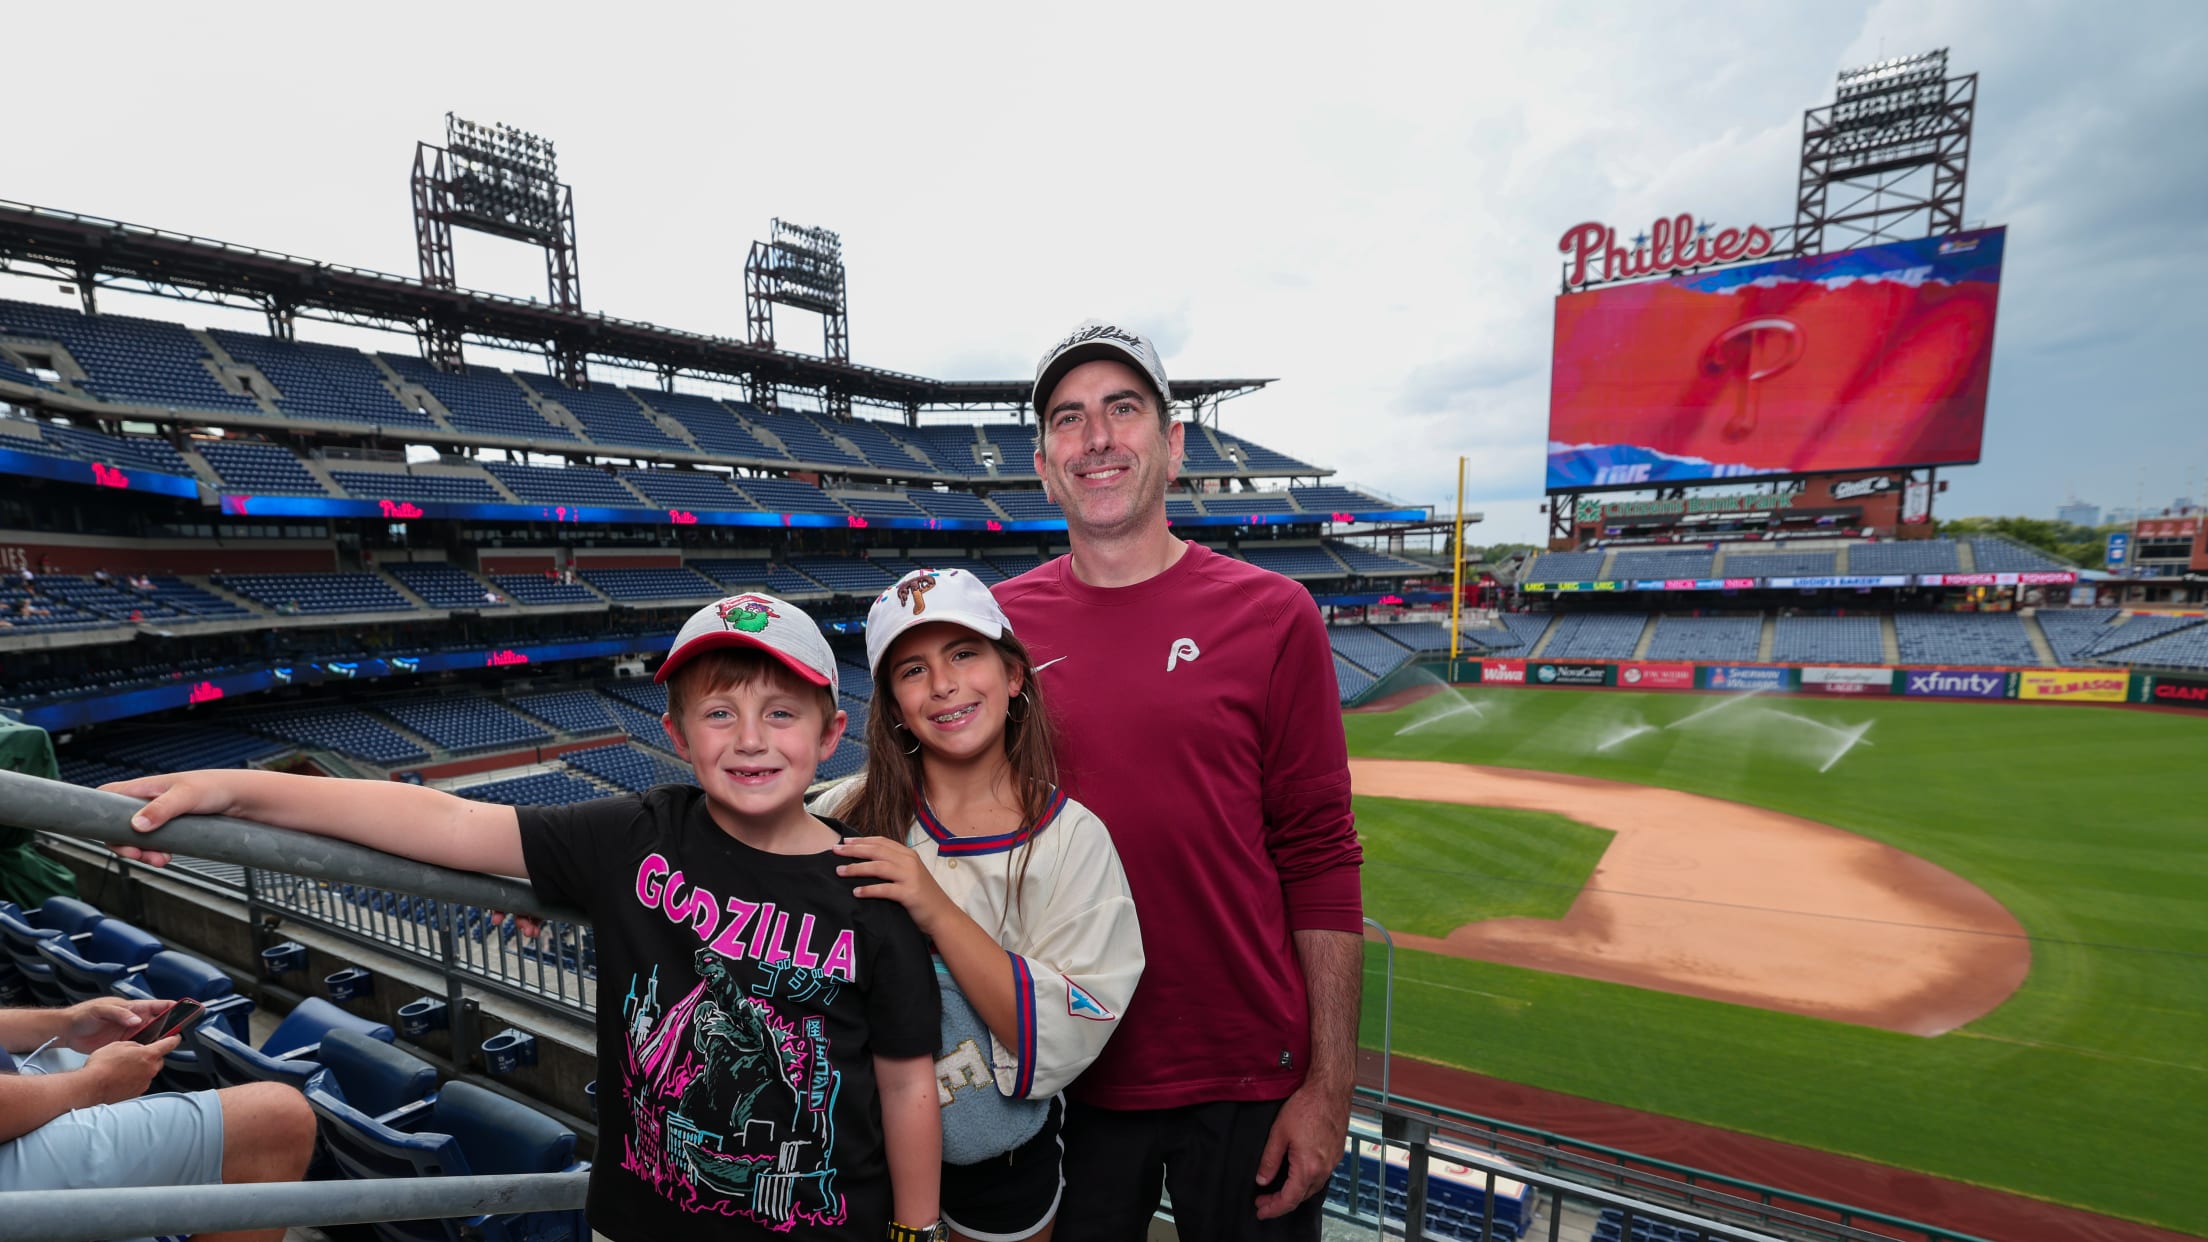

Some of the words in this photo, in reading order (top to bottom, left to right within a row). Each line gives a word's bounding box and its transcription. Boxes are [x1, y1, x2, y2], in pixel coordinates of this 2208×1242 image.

[1559, 213, 1772, 286] Phillies
[1049, 325, 1144, 359] Phillies
[1605, 500, 1685, 517] Citizens
[1688, 496, 1741, 513] Bank
[1744, 491, 1793, 509] Park
[1944, 574, 1995, 585] TOYOTA
[2021, 572, 2074, 584] TOYOTA
[1166, 637, 1201, 672] P
[1484, 667, 1524, 681] Wawa
[1557, 666, 1605, 678] NovaCare
[1910, 671, 2000, 693] xfinity
[635, 853, 856, 983] GODZILLA
